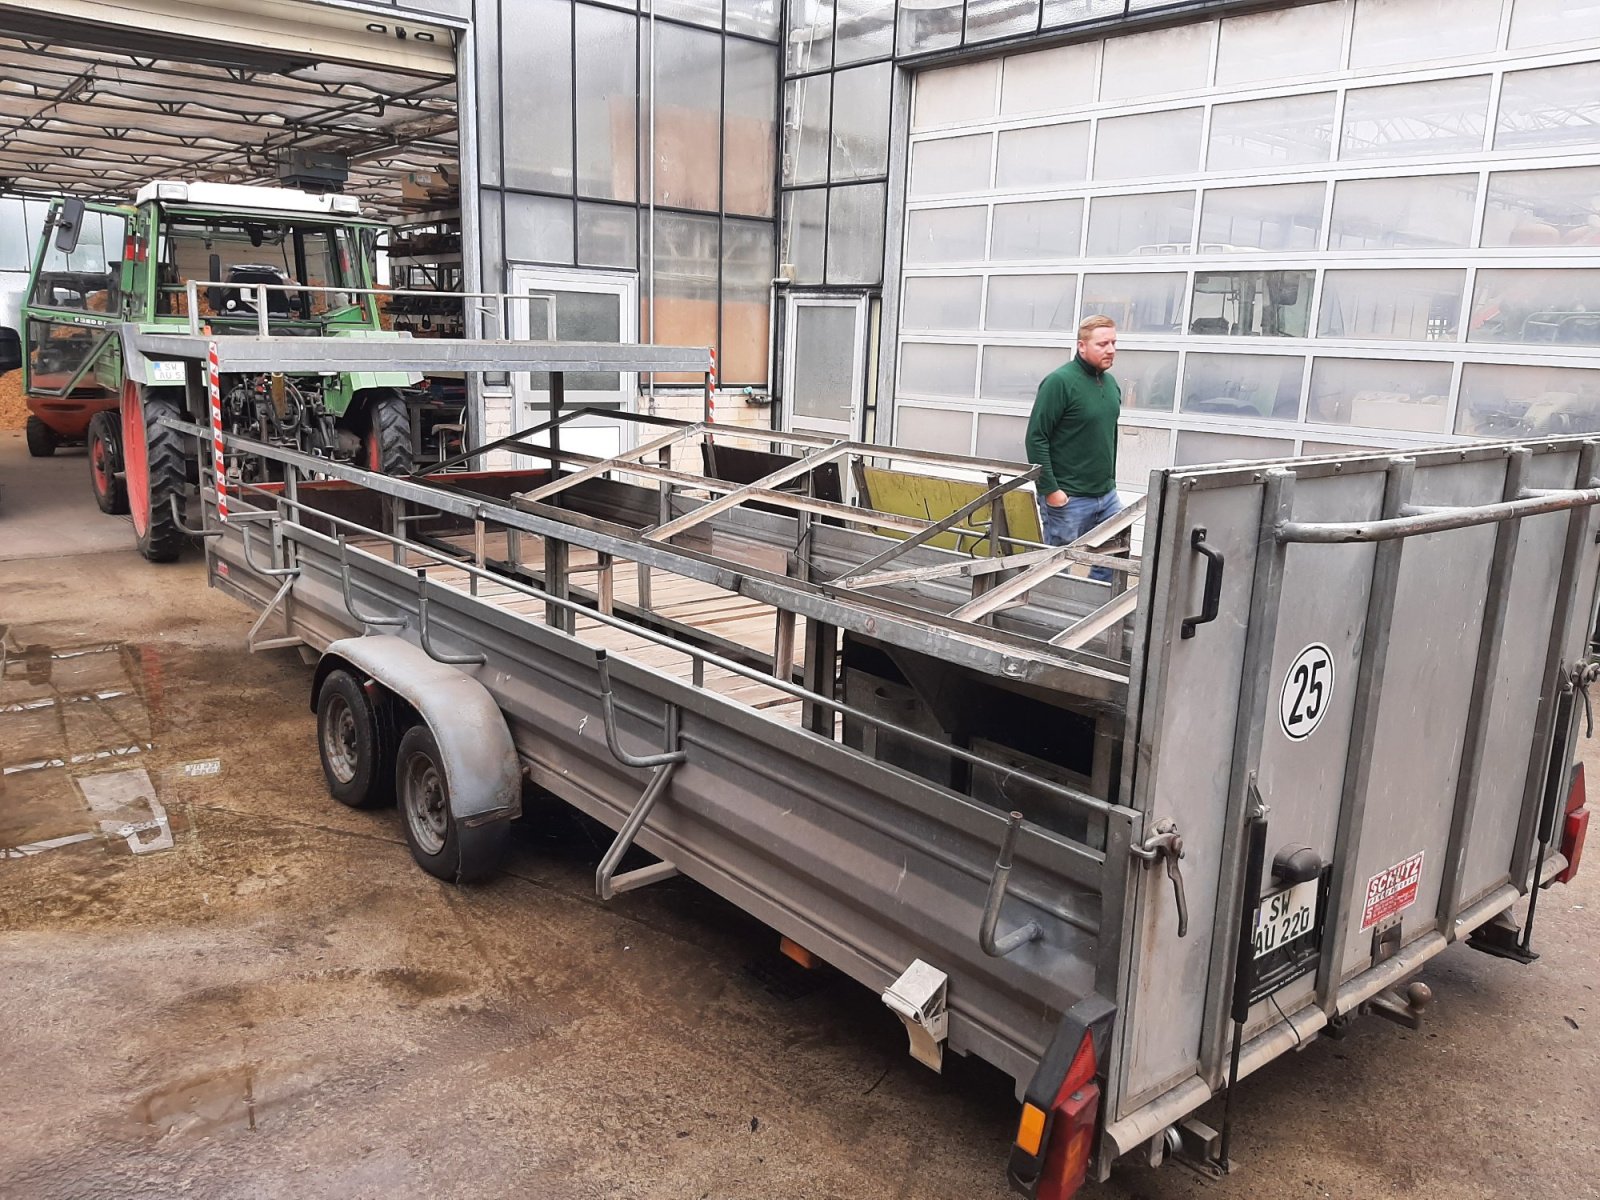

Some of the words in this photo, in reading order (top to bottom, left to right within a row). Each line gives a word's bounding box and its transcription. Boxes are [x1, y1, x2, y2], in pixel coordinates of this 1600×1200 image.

[1288, 660, 1326, 725] 25
[1269, 889, 1292, 922] SW
[1281, 907, 1310, 944] 220
